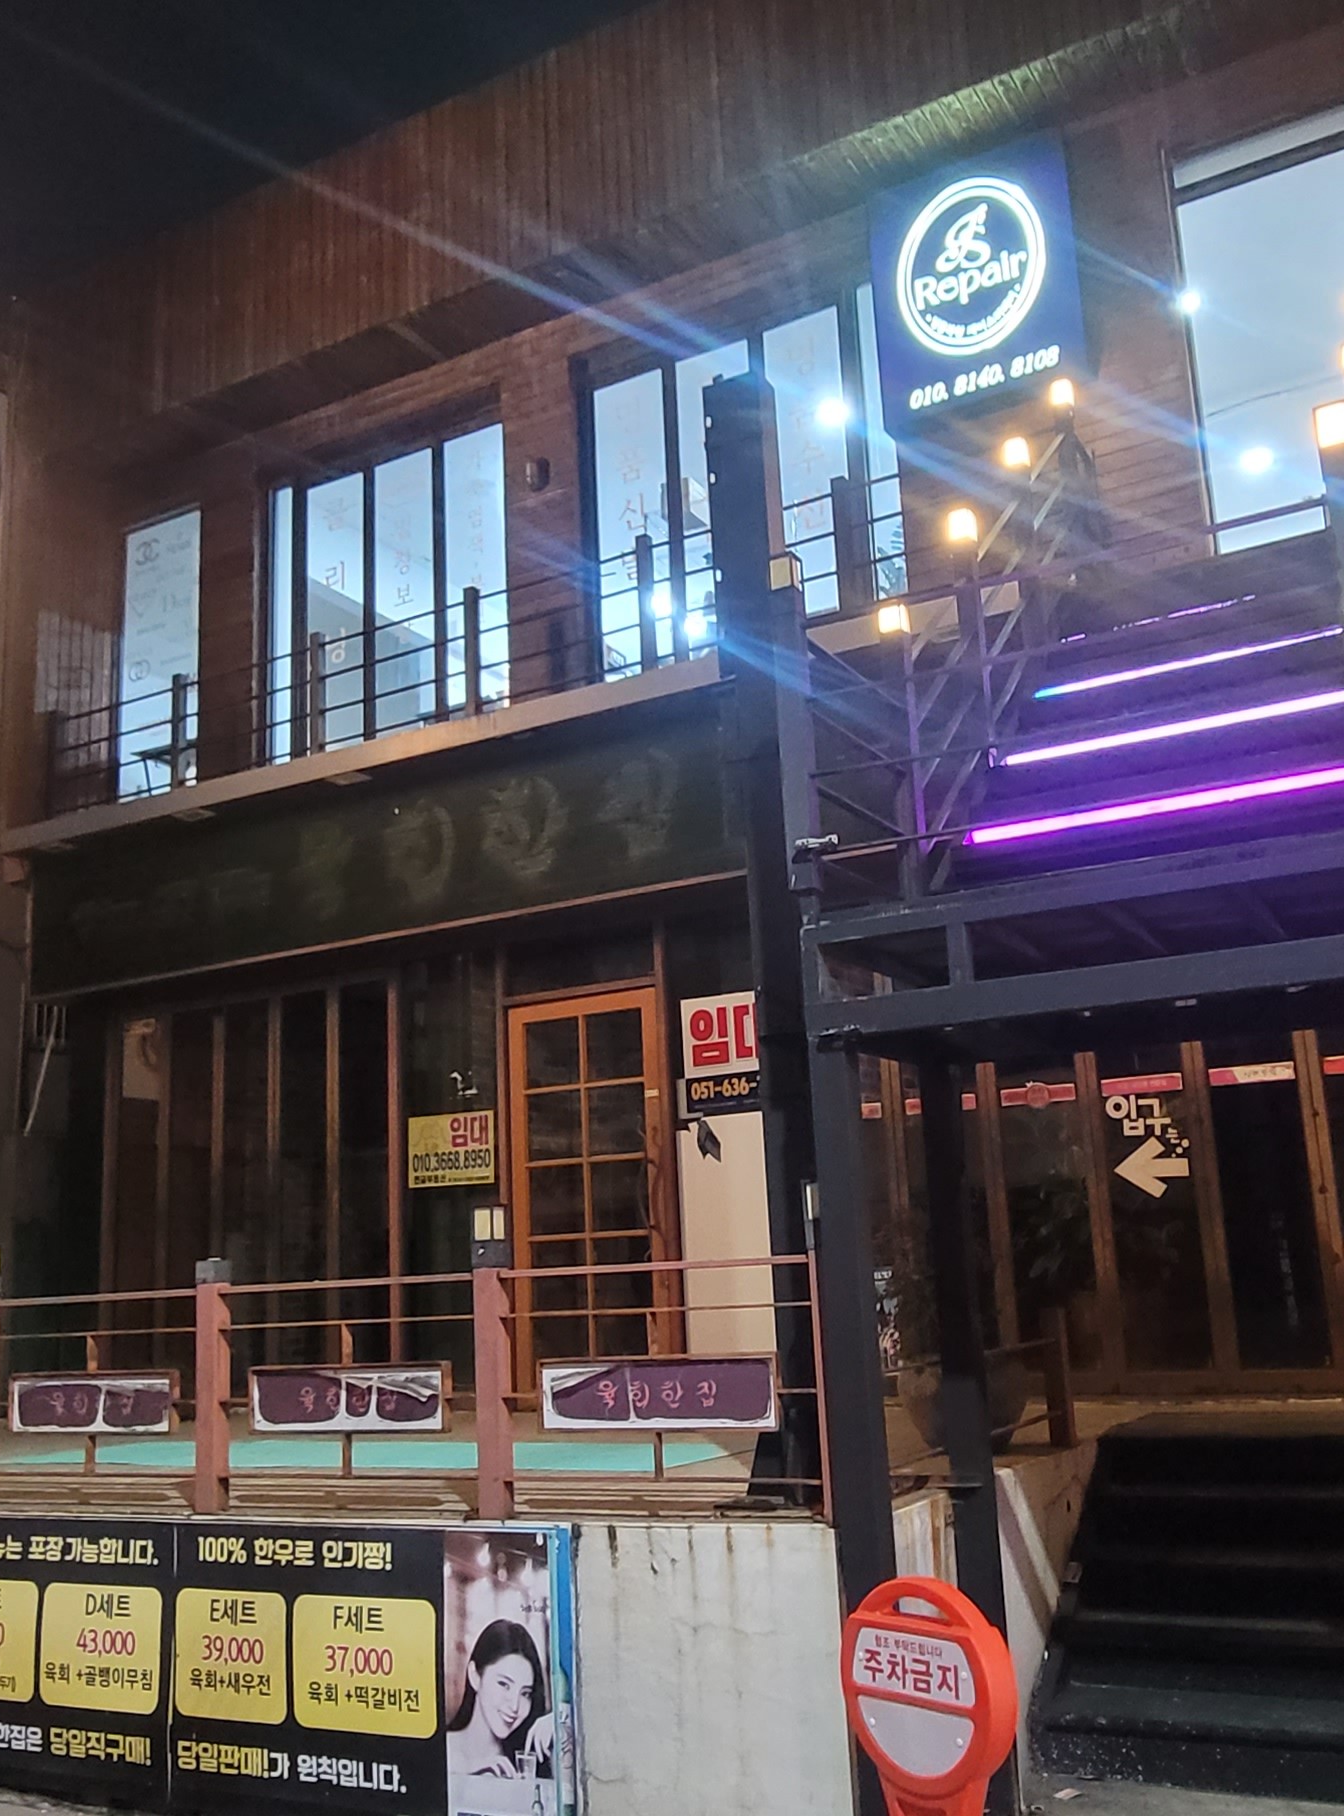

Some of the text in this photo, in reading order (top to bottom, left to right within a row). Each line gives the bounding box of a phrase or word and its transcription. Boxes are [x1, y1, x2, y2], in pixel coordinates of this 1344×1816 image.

[913, 249, 1029, 311] Repair
[1010, 344, 1060, 378] 8108
[450, 1114, 489, 1148] 임대
[28, 1536, 63, 1561] 포장
[64, 1536, 159, 1566] 가능합니다.
[198, 1536, 393, 1571] 100% 한우로 인기짱!
[85, 1593, 131, 1620] D세트
[210, 1598, 257, 1626] E세트
[333, 1605, 384, 1634] F세트
[75, 1628, 136, 1657] 43,000
[201, 1634, 264, 1666] 39,000
[44, 1662, 70, 1684] 육회
[324, 1644, 393, 1678] 37,000
[863, 1649, 960, 1700] 주차금지
[189, 1667, 272, 1697] 육회+새우전
[308, 1681, 339, 1706] 육회
[49, 1727, 152, 1767] 당일직구매!
[297, 1753, 407, 1794] 원칙입니다.
